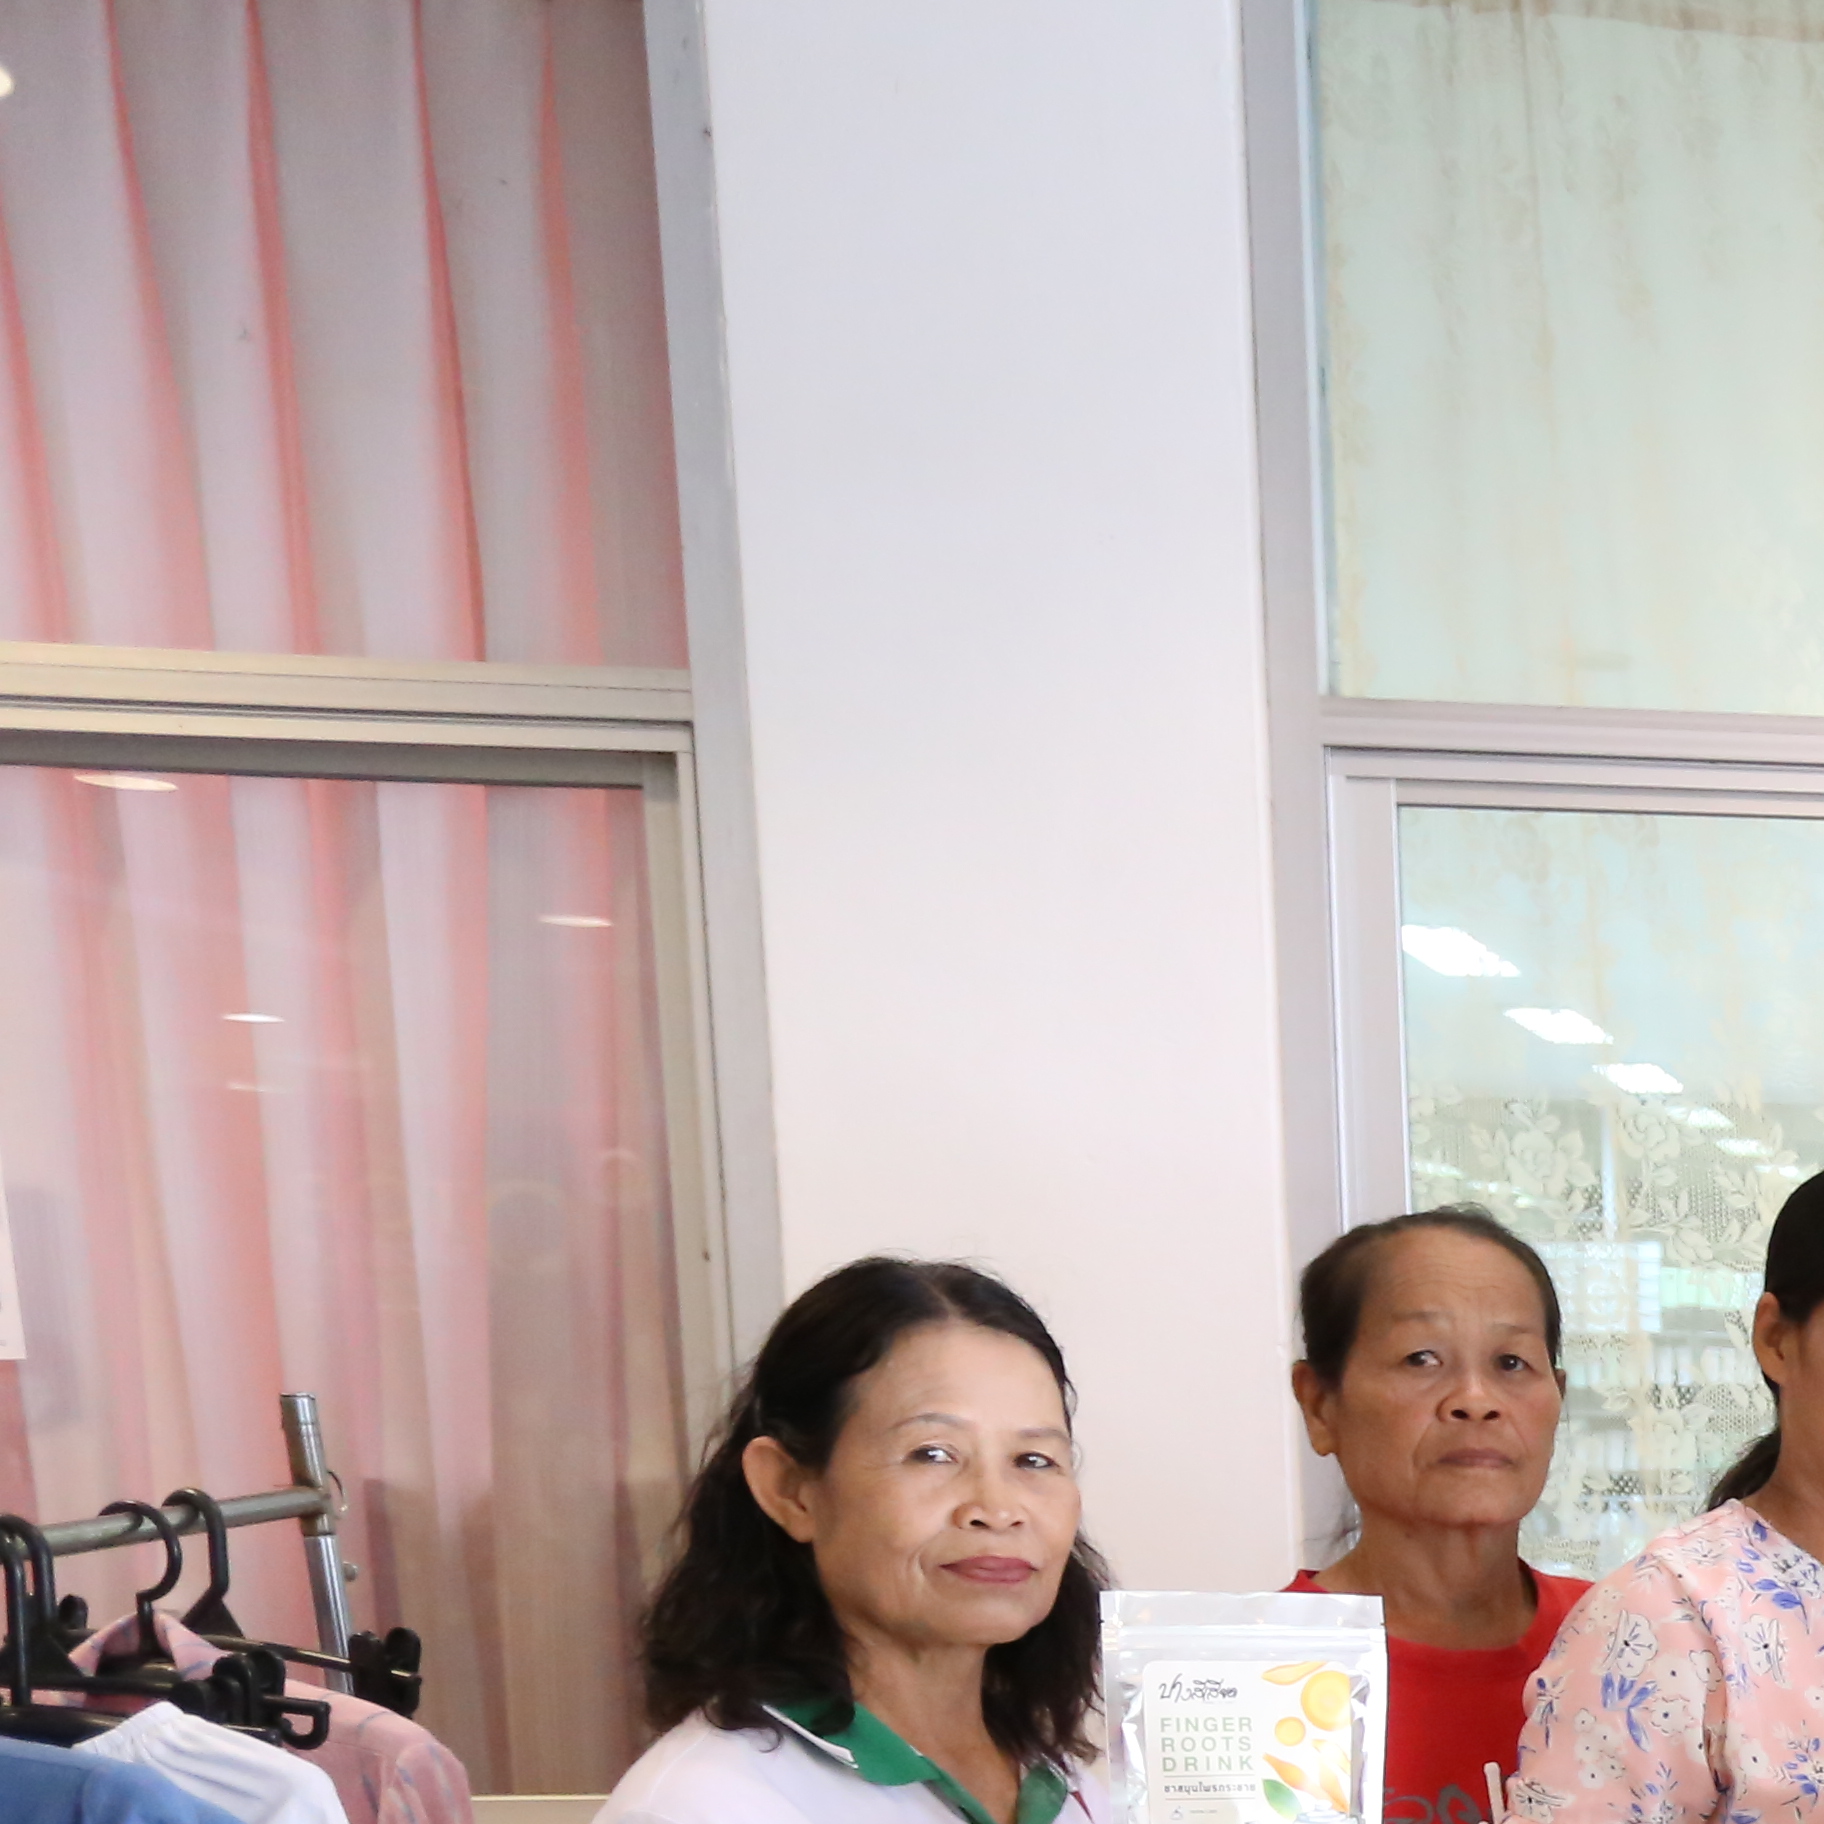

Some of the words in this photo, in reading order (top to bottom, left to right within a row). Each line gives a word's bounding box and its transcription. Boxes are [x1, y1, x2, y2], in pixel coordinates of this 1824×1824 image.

[1160, 1717, 1252, 1733] FINGER
[1161, 1736, 1252, 1752] ROOTS
[1162, 1756, 1254, 1772] DRINK
